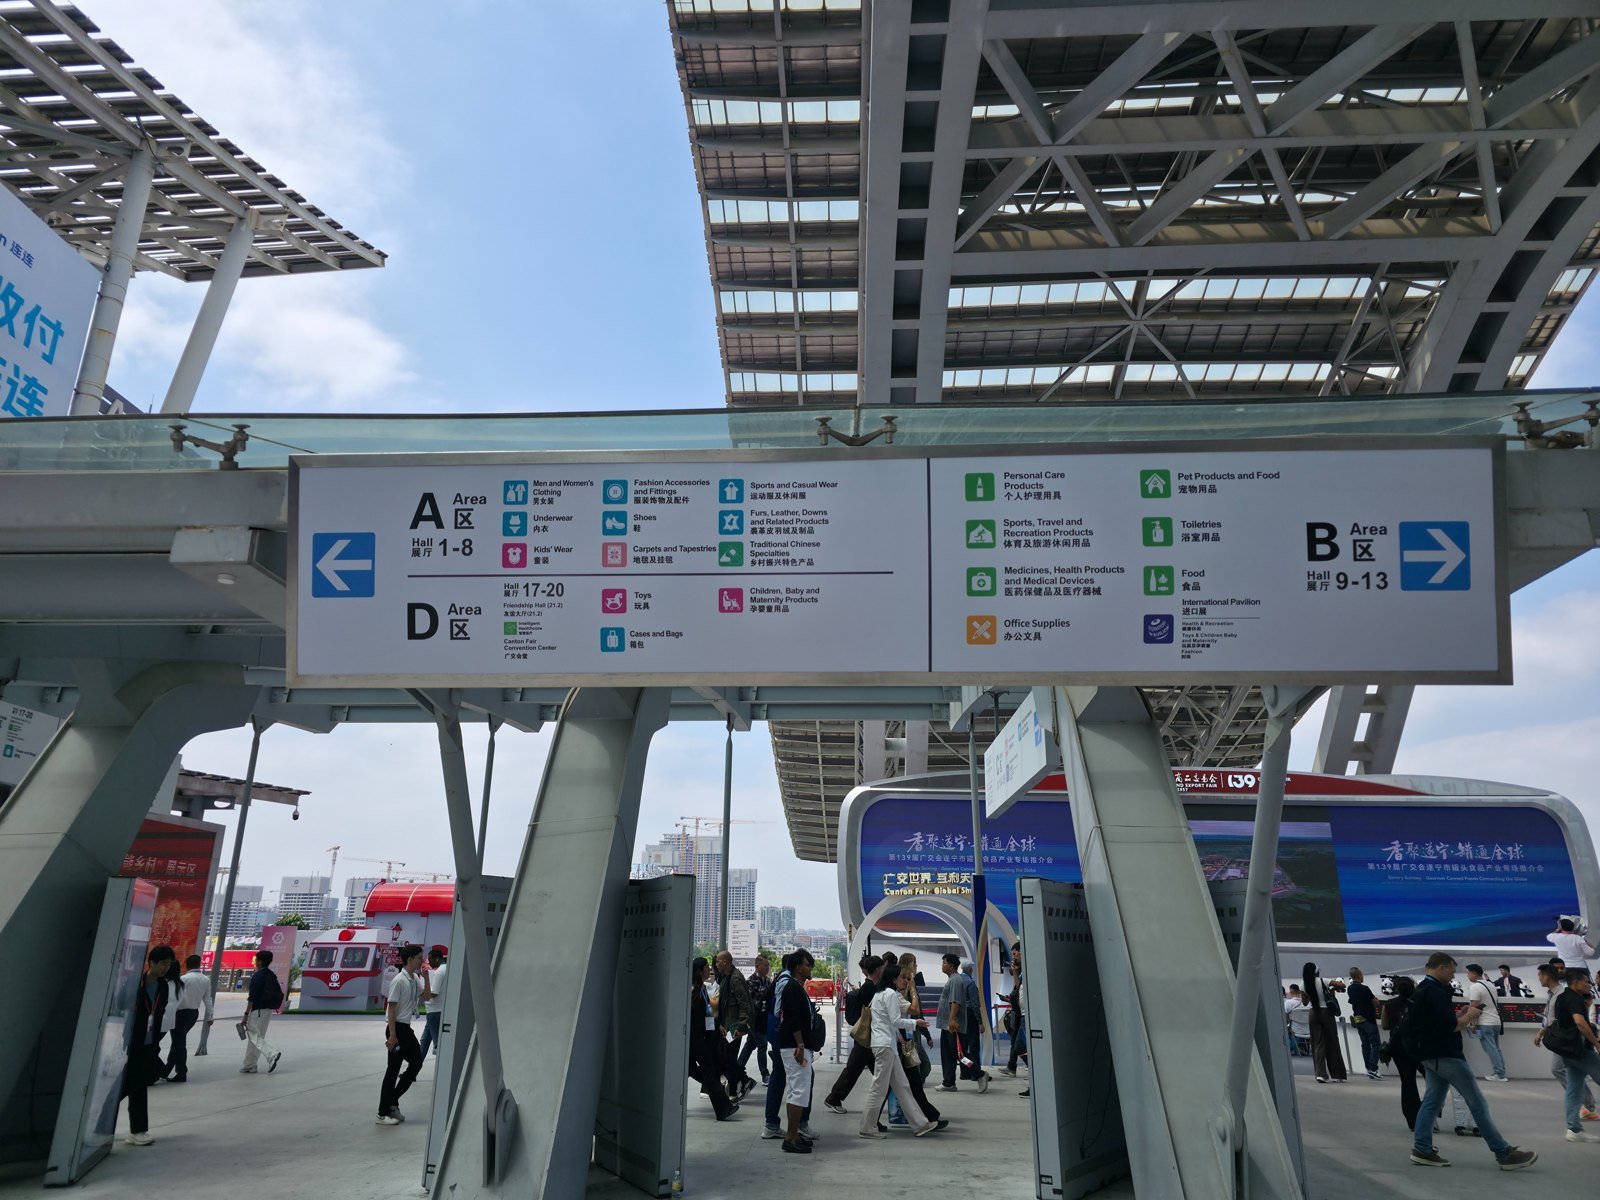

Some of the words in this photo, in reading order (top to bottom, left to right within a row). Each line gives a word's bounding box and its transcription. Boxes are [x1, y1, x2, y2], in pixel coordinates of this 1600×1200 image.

[10, 240, 35, 268] 连连
[0, 357, 48, 416] 连
[1003, 471, 1043, 480] Personal
[1044, 470, 1066, 479] Care
[1177, 472, 1193, 481] Pet
[1194, 472, 1236, 481] Products
[1237, 471, 1255, 480] and
[1256, 471, 1281, 480] Food
[750, 481, 775, 490] Sports
[1004, 481, 1044, 490] Products
[1178, 484, 1218, 494] 宠物用品
[532, 488, 562, 498] Clothing
[649, 487, 678, 497] Fittings
[750, 491, 807, 501] 运动服及休闲服
[1004, 490, 1062, 501] 个人护理用具
[452, 492, 487, 505] Area
[532, 496, 554, 506] 男女装
[633, 496, 690, 505] 服装饰物及配件
[409, 492, 445, 530] A
[454, 507, 475, 530] 区
[1003, 518, 1035, 528] Sports,
[1036, 517, 1064, 526] Travel
[1065, 517, 1083, 526] and
[533, 524, 549, 534] 内衣
[633, 524, 641, 533] 鞋
[1180, 520, 1222, 529] Toiletries
[1350, 522, 1388, 536] Area
[1003, 528, 1052, 538] Recreation
[1053, 528, 1094, 537] Products
[1181, 532, 1221, 543] 浴室用品
[412, 537, 433, 547] Hall
[1003, 538, 1091, 549] 体育及旅游休闲用品
[1306, 521, 1341, 562] B
[411, 547, 433, 558] 展厅
[438, 538, 474, 557] 1-8
[632, 545, 662, 554] Carpets
[678, 544, 717, 554] Tapestries
[1352, 538, 1376, 562] 区
[749, 549, 791, 559] Specialties
[533, 556, 550, 565] 童装
[632, 555, 674, 565] 地毯及挂毯
[750, 558, 815, 567] 乡村振兴特色产品
[1004, 566, 1052, 575] Medicines,
[1053, 565, 1083, 574] Health
[1084, 565, 1126, 574] Products
[1181, 568, 1206, 578] Food
[1307, 570, 1331, 581] Hall
[1004, 577, 1022, 586] and
[1023, 576, 1058, 585] Medical
[1059, 576, 1095, 585] Devices
[1306, 580, 1330, 592] 展厅
[1335, 571, 1389, 591] 9-13
[522, 582, 565, 598] 17-20
[785, 587, 805, 596] Baby
[1004, 586, 1102, 597] 医药保健品及医疗器械
[1182, 581, 1201, 592] 食品
[503, 589, 519, 598] 展厅
[633, 591, 652, 601] Toys
[749, 596, 784, 605] Maternity
[447, 602, 482, 616] Area
[634, 601, 650, 611] 玩具
[750, 604, 790, 614] 孕婴童用品
[1182, 606, 1207, 616] 进口展
[406, 602, 439, 641] D
[1003, 618, 1031, 628] Office
[1031, 618, 1071, 630] Supplies
[449, 618, 471, 641] 区
[665, 629, 684, 639] Bags
[1003, 631, 1042, 642] 办公文具
[629, 640, 645, 649] 箱包
[1227, 774, 1256, 788] 139
[888, 854, 1053, 864] 第139届广交会遂宁市罐食品产业专场推介会
[884, 872, 931, 884] 广交世界
[937, 872, 976, 884] 互利天
